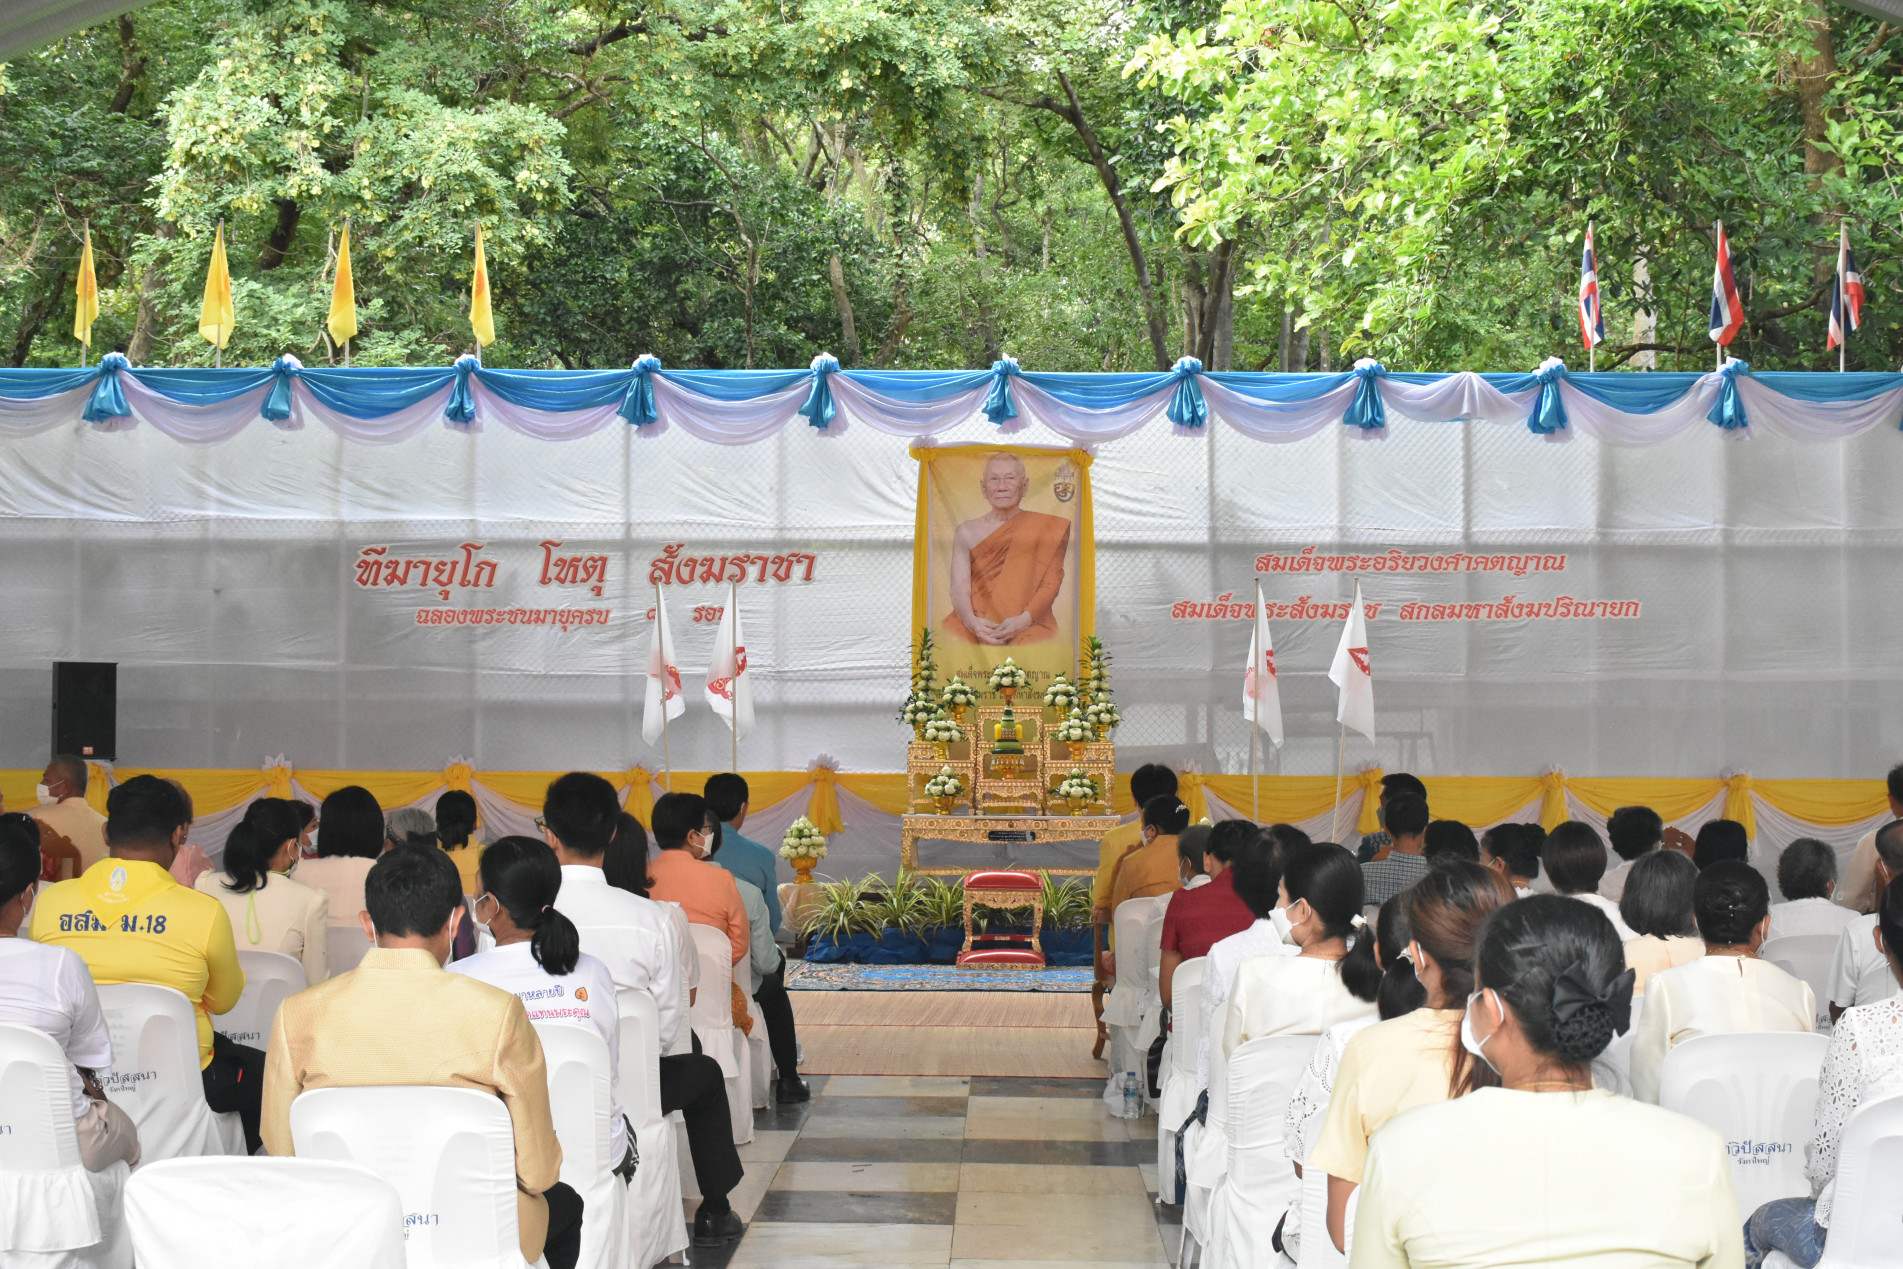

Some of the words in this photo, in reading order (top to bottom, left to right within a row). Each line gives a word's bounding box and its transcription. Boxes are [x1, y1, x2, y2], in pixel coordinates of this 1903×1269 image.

[355, 542, 499, 601] ทีฆายุโก
[538, 539, 609, 597] โหตุ
[648, 542, 816, 585] สังฆราชา
[1255, 545, 1567, 577] สมเด็จพระอริยวงศาคตญาณ
[415, 608, 611, 632] ฉลองพระชนมายุครบ
[1171, 592, 1383, 620] สมเด็จระสังฆรช
[1399, 594, 1640, 621] สกลมหาสังฆปริณายก
